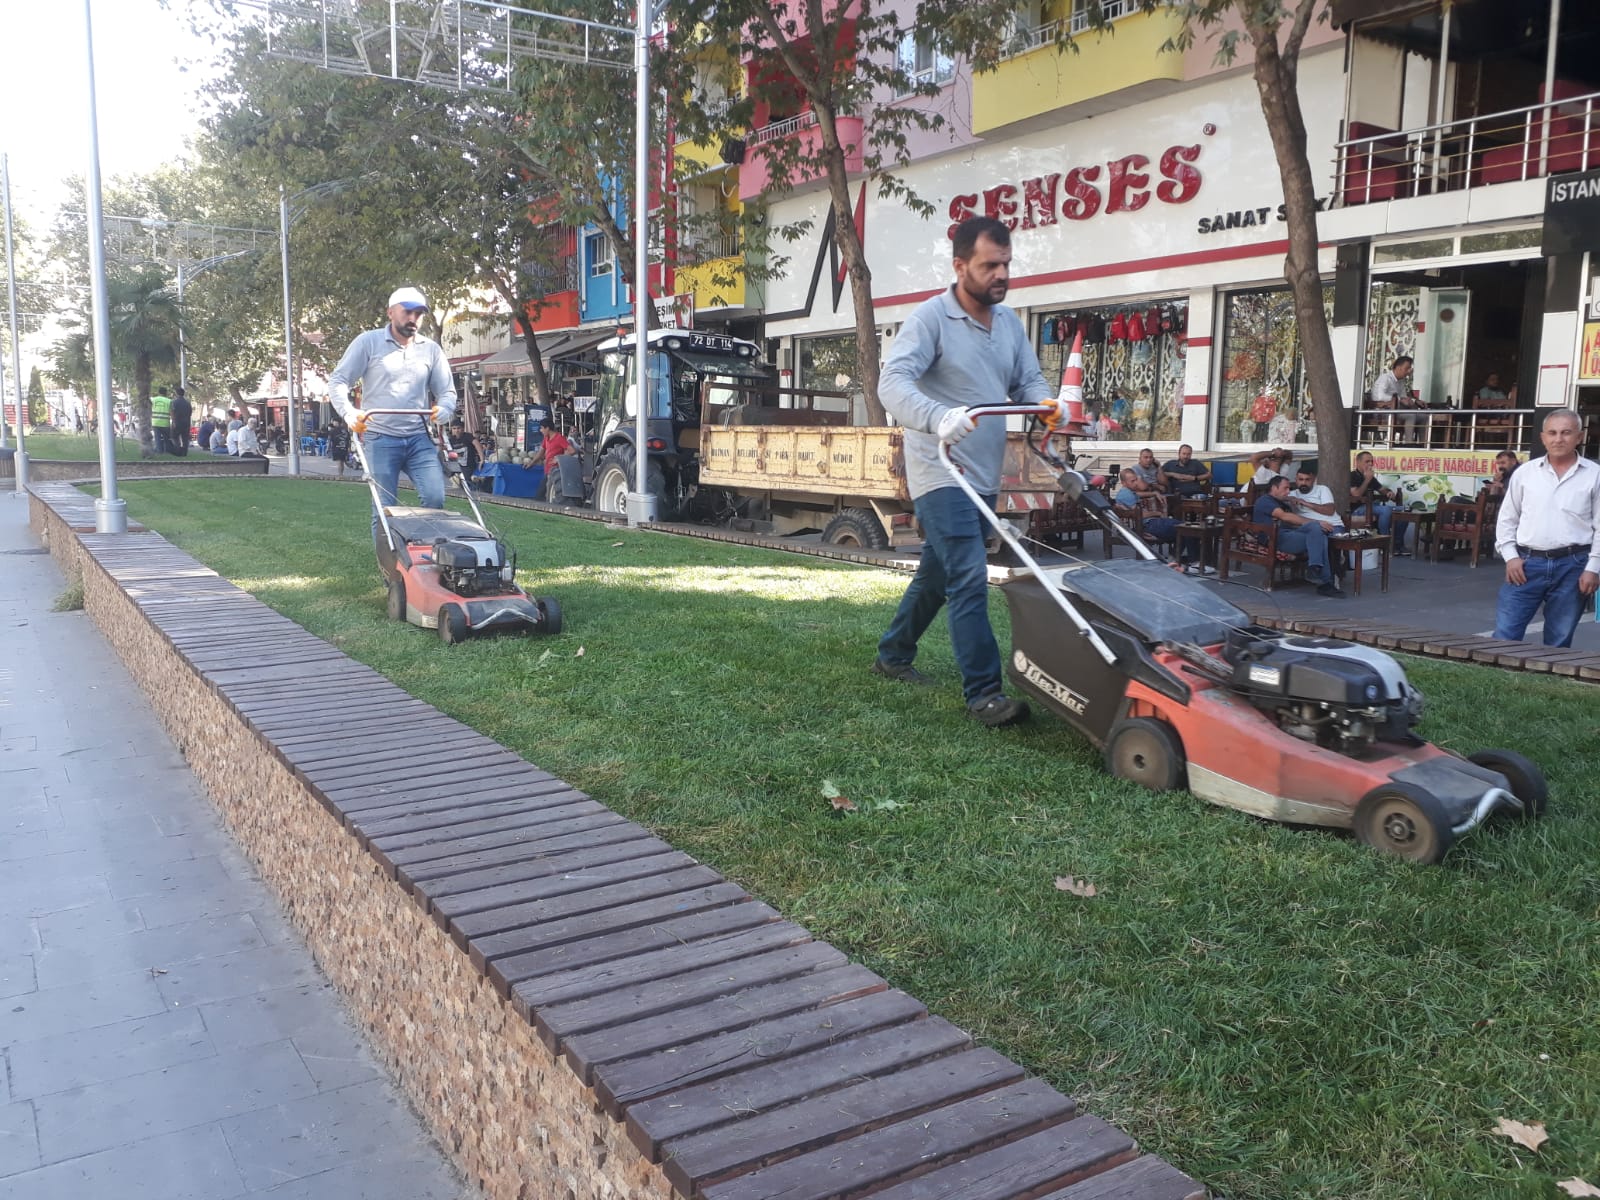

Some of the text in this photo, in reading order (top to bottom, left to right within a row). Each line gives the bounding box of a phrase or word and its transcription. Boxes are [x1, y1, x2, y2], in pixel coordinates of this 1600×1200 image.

[947, 143, 1203, 241] SENSES
[1197, 206, 1271, 234] SANAT
[659, 320, 676, 329] RKET
[694, 335, 732, 348] 72 DT 114
[1353, 452, 1398, 471] İNBUL
[1443, 455, 1489, 474] NARGİLE
